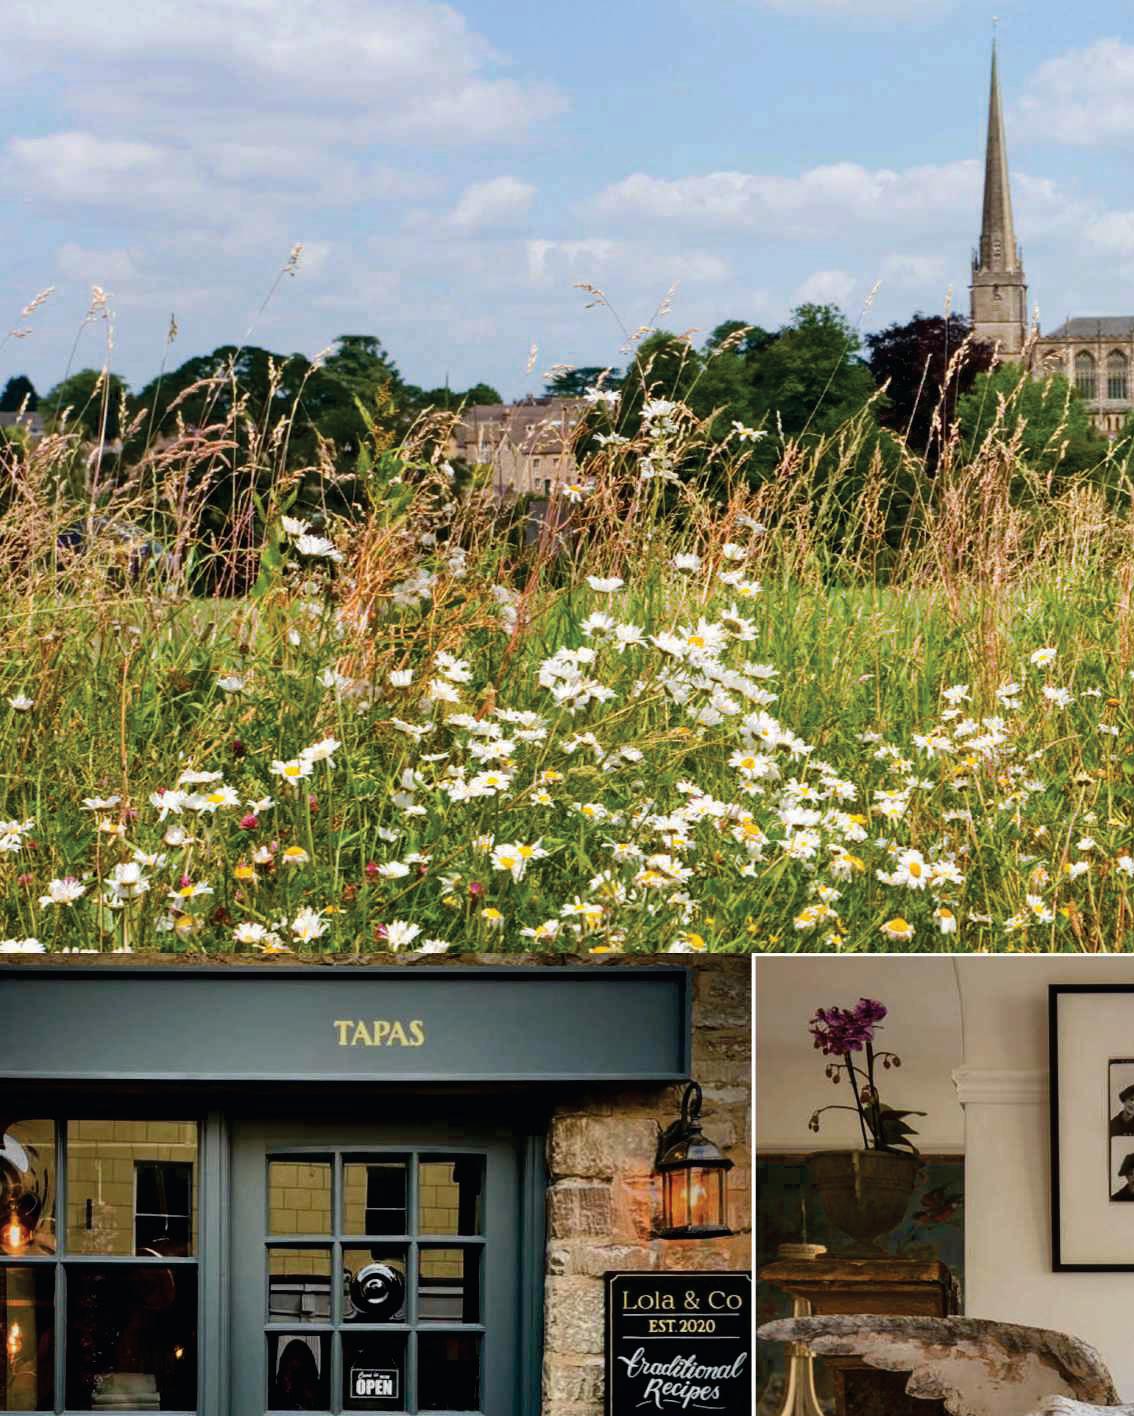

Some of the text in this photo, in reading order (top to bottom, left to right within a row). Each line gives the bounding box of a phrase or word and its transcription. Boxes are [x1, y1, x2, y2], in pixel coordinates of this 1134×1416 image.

[333, 1020, 425, 1046] TAPAS
[622, 1290, 743, 1310] Lola & Co
[356, 1379, 393, 1395] OPEN
[643, 1377, 720, 1409] Recipes
